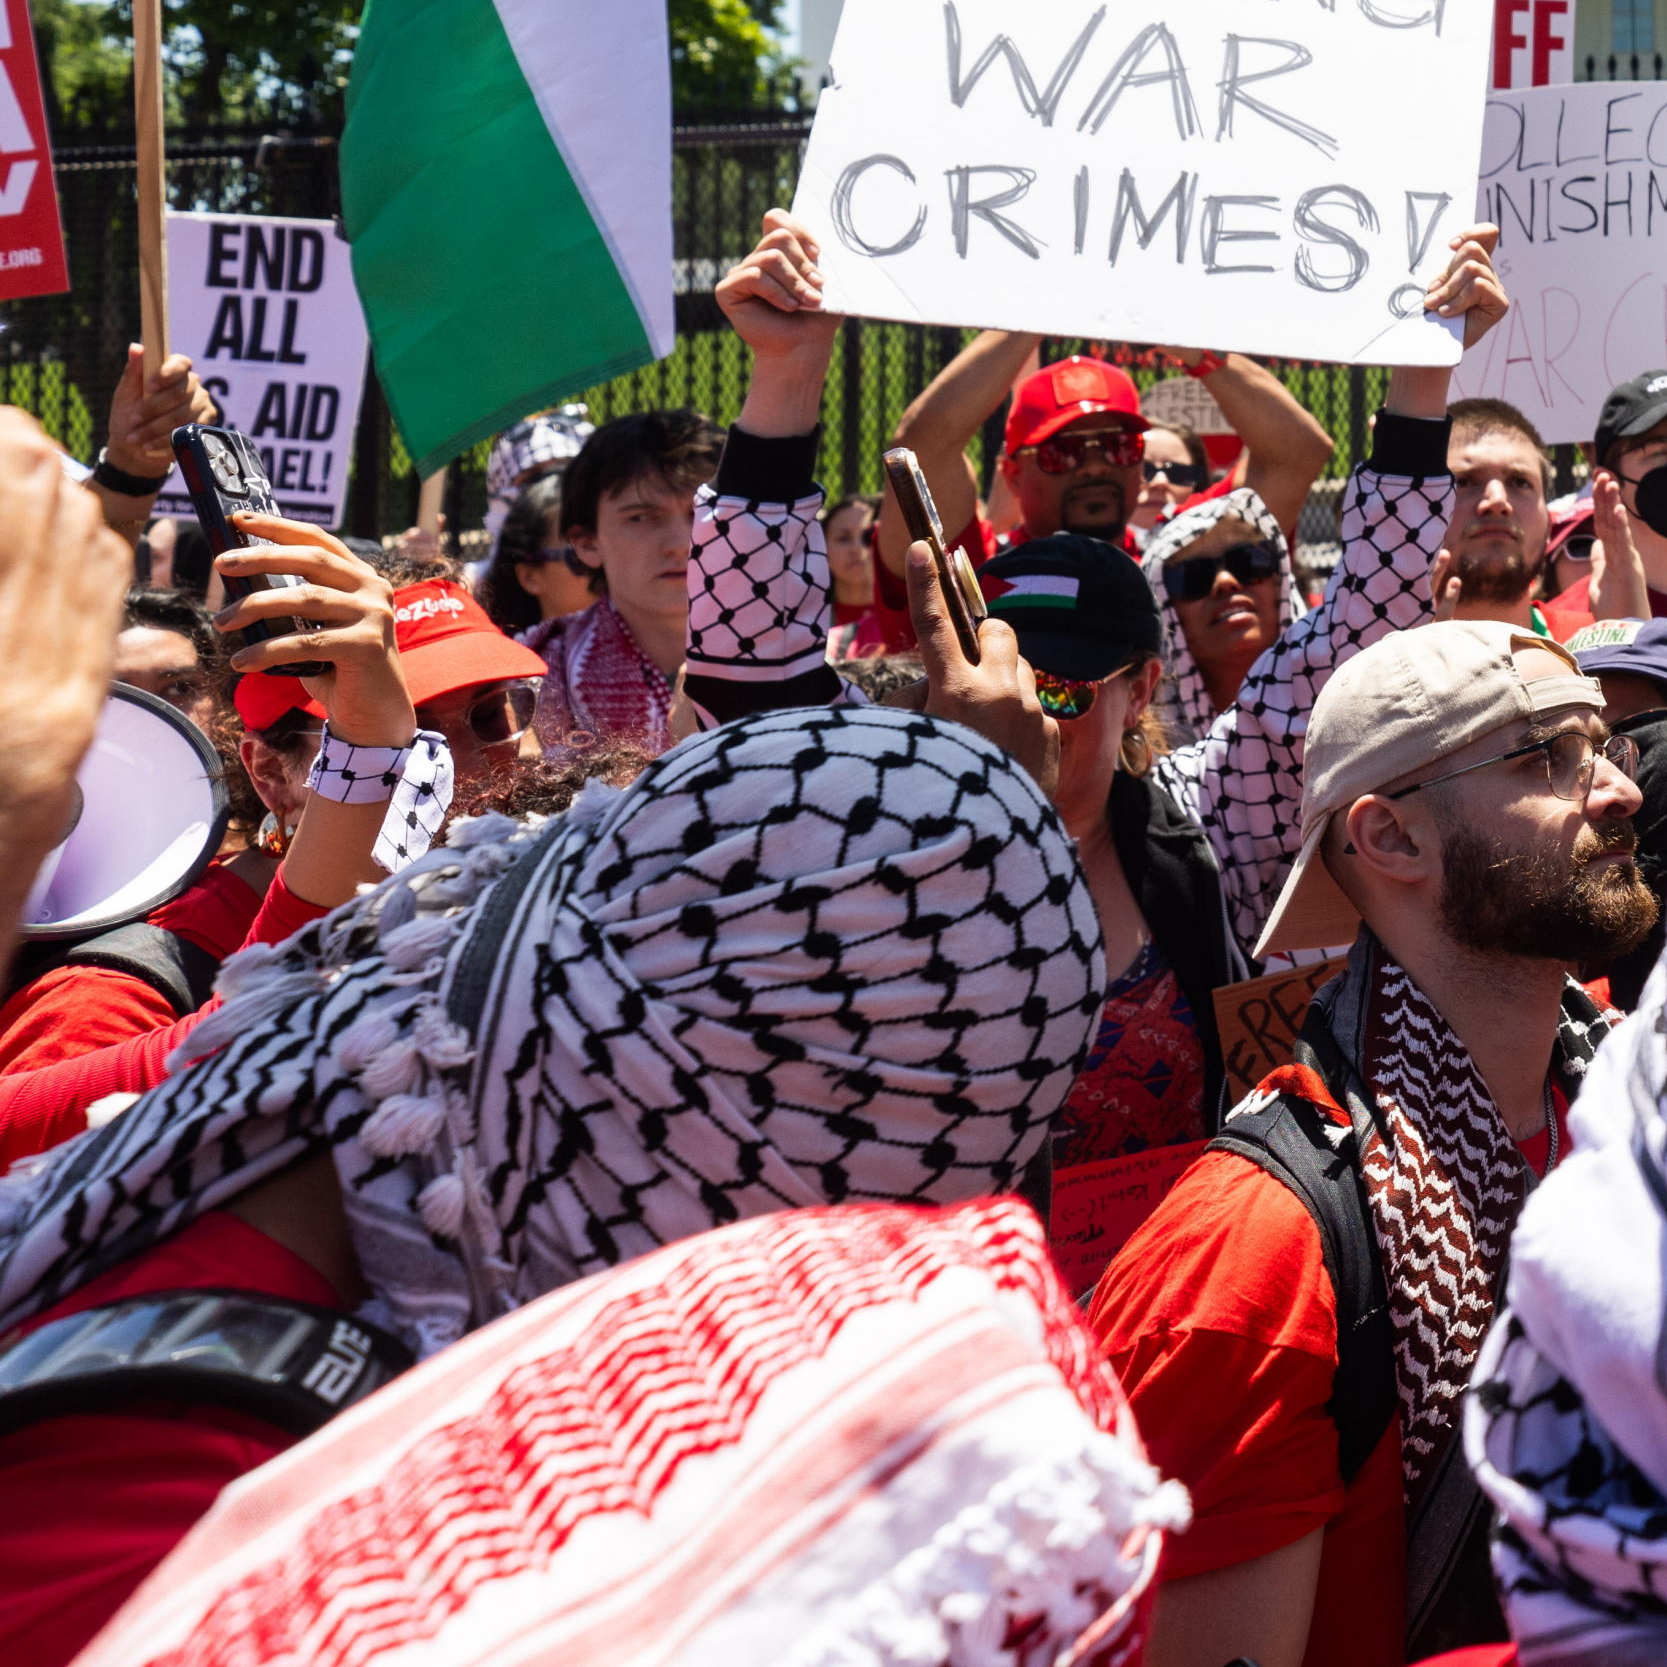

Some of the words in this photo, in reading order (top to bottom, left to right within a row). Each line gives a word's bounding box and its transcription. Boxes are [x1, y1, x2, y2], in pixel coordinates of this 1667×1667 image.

[944, 0, 1339, 160] WAR
[205, 223, 325, 294] END
[830, 153, 1453, 321] CRIMES!
[204, 297, 307, 365] ALL
[251, 382, 340, 442] AID
